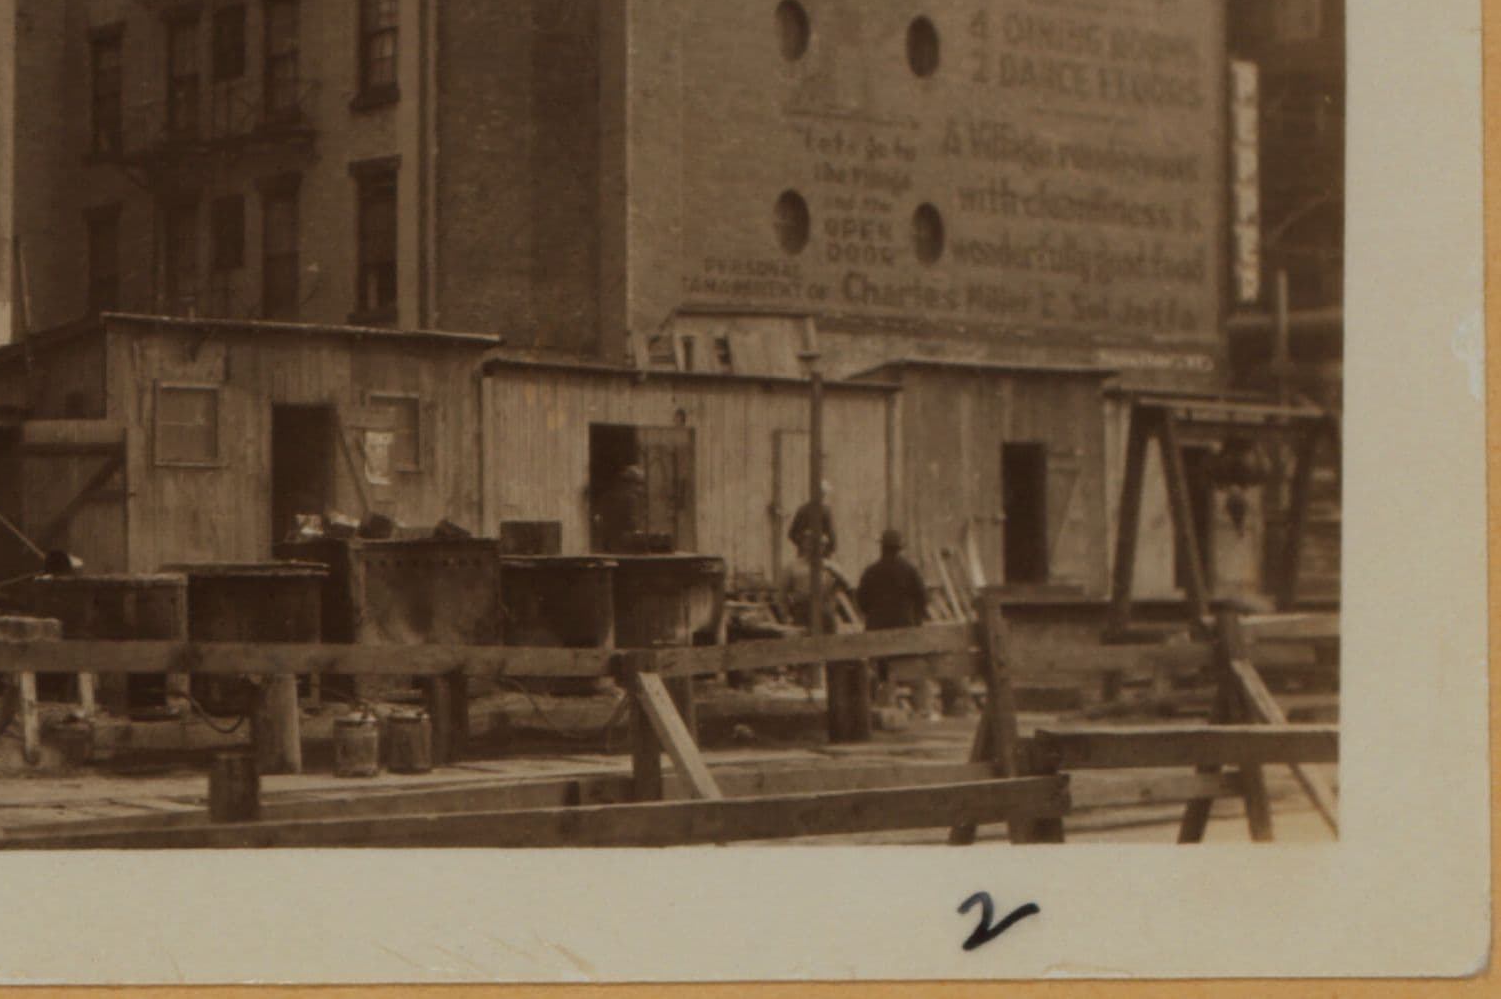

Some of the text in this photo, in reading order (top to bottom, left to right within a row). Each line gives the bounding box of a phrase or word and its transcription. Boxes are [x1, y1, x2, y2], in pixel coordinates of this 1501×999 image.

[969, 8, 989, 41] 4
[940, 117, 963, 156] A
[843, 268, 962, 310] Charles
[958, 891, 1041, 951] 2
